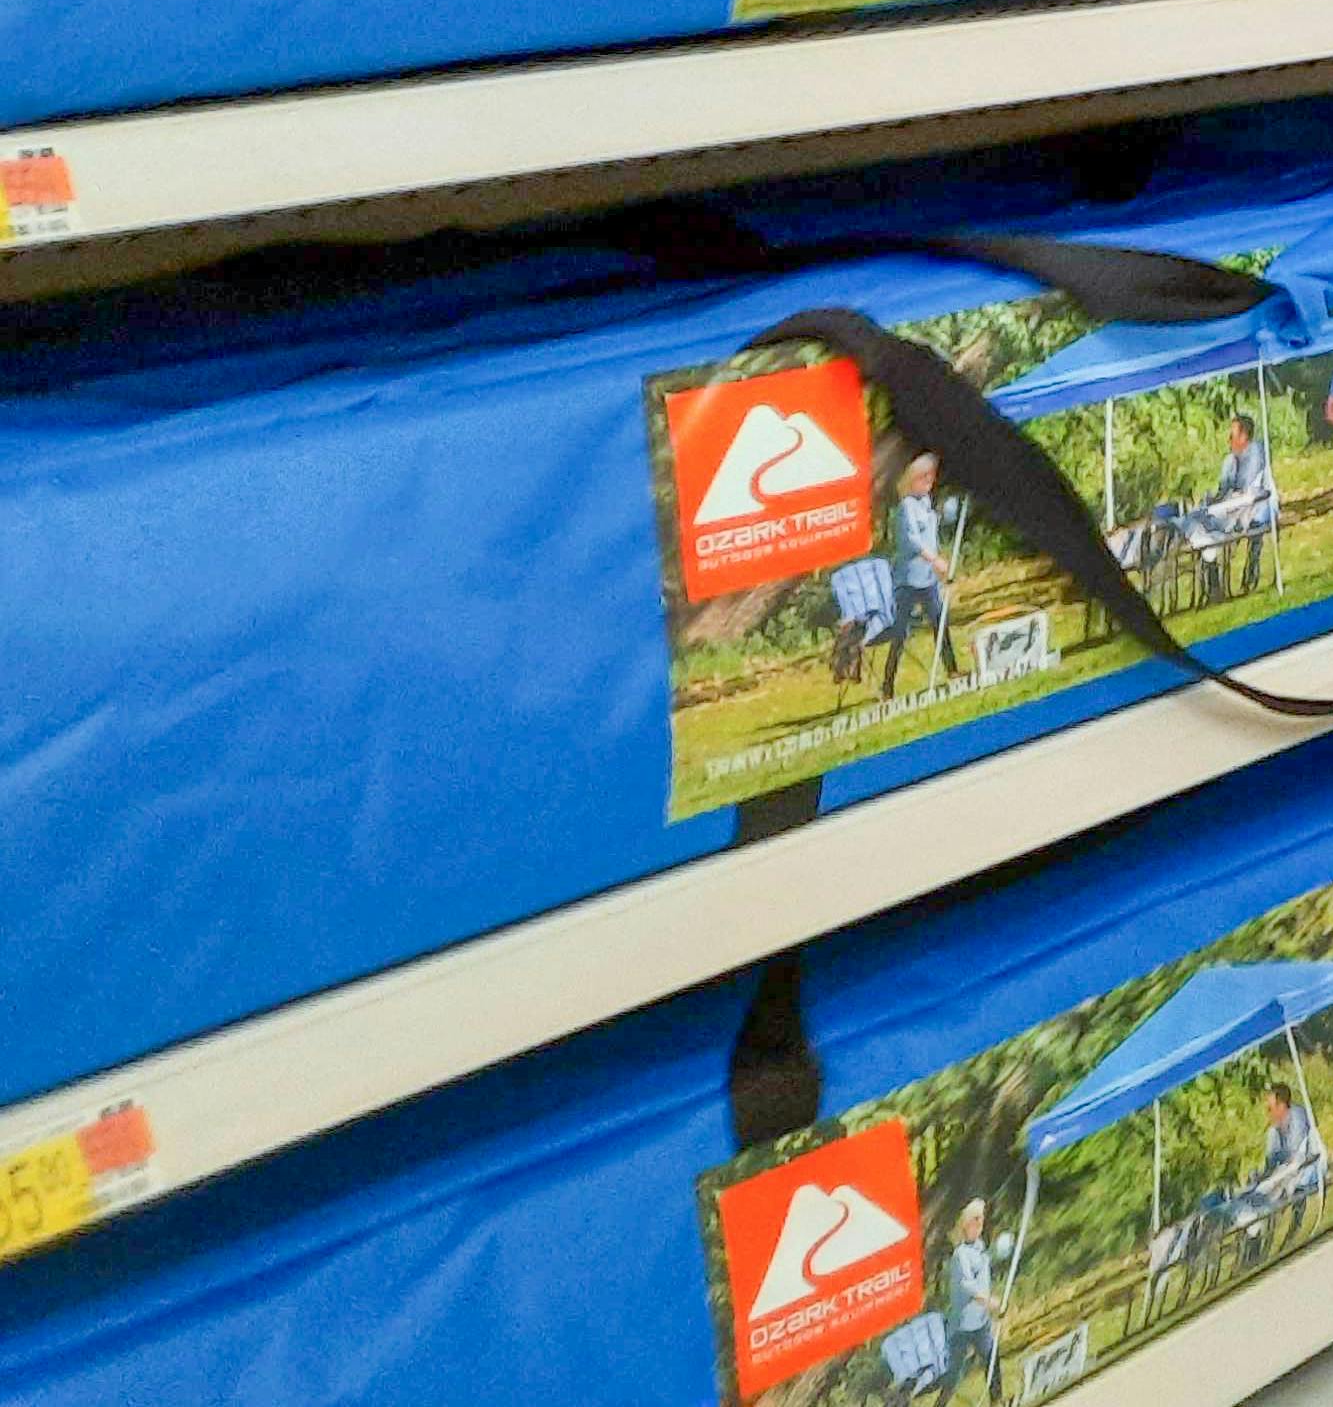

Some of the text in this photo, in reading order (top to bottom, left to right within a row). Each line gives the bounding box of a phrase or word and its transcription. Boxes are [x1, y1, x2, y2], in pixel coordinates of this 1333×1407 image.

[695, 498, 858, 558] OZARK TRAIL
[750, 1260, 913, 1350] OZARK TRAIL
